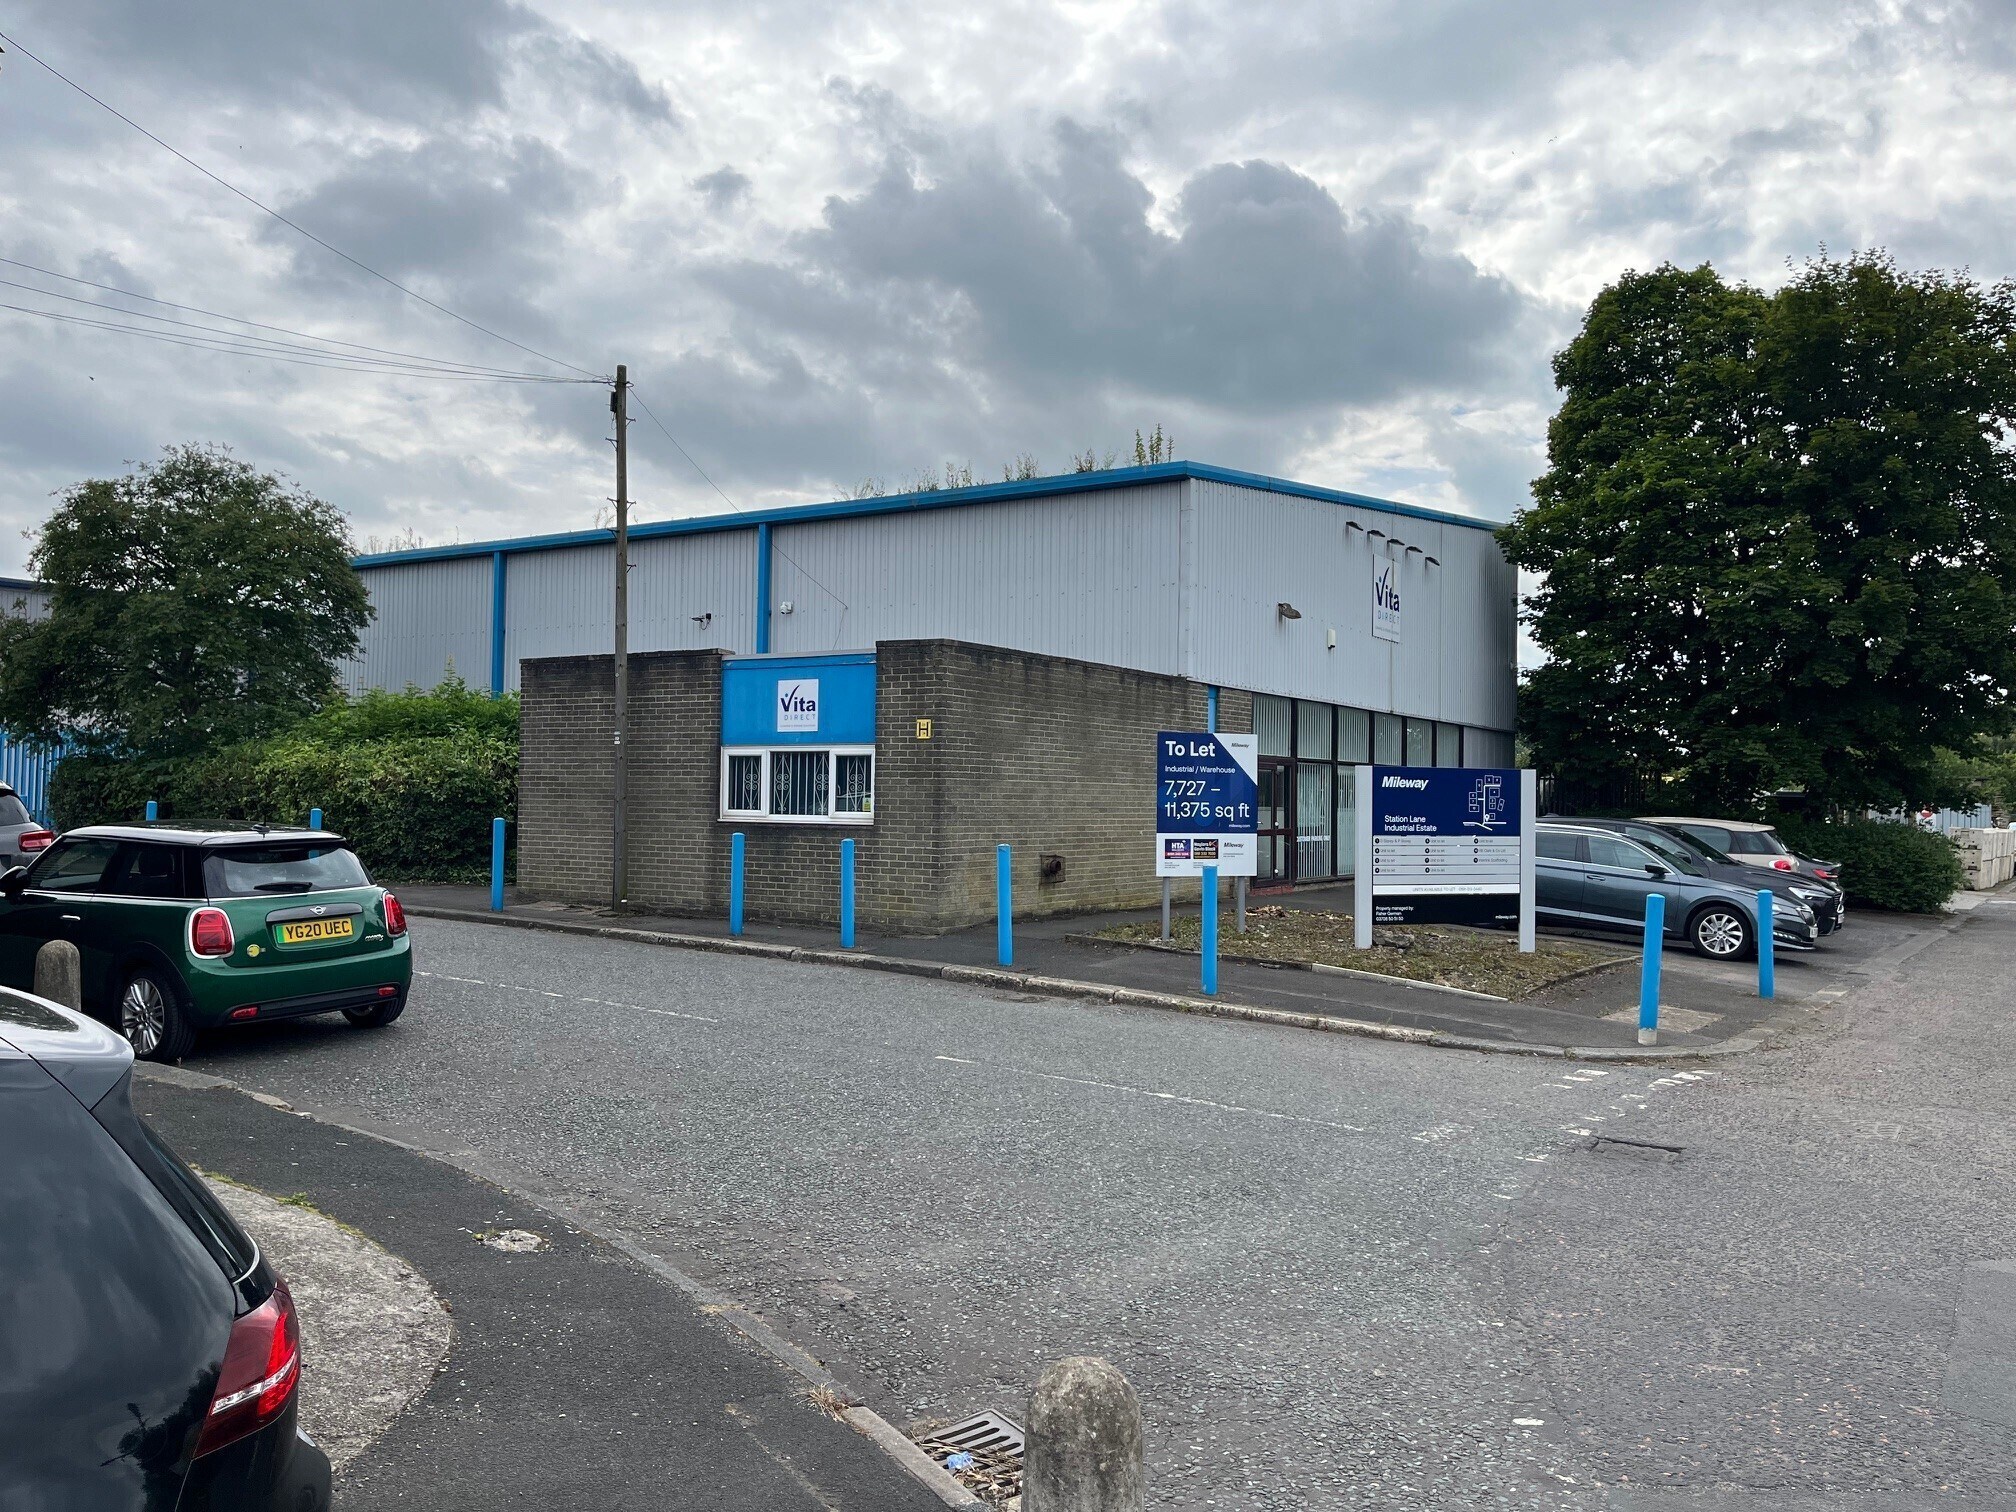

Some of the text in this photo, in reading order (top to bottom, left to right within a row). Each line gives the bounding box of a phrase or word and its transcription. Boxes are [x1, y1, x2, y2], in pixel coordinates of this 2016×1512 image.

[1376, 567, 1399, 612] Vita
[1378, 610, 1399, 624] DIRECT
[780, 685, 815, 712] Vita
[919, 722, 928, 737] H
[1165, 741, 1216, 757] To Let
[1165, 765, 1195, 773] Industrial
[1200, 766, 1236, 774] Warehouse
[1165, 780, 1206, 797] 7,727
[1382, 776, 1429, 790] Mileway
[1165, 802, 1250, 821] 11,375 sq ft
[1385, 815, 1408, 823] Station
[1385, 824, 1437, 832] Industrial Estate
[286, 921, 350, 939] YG20 UEC
